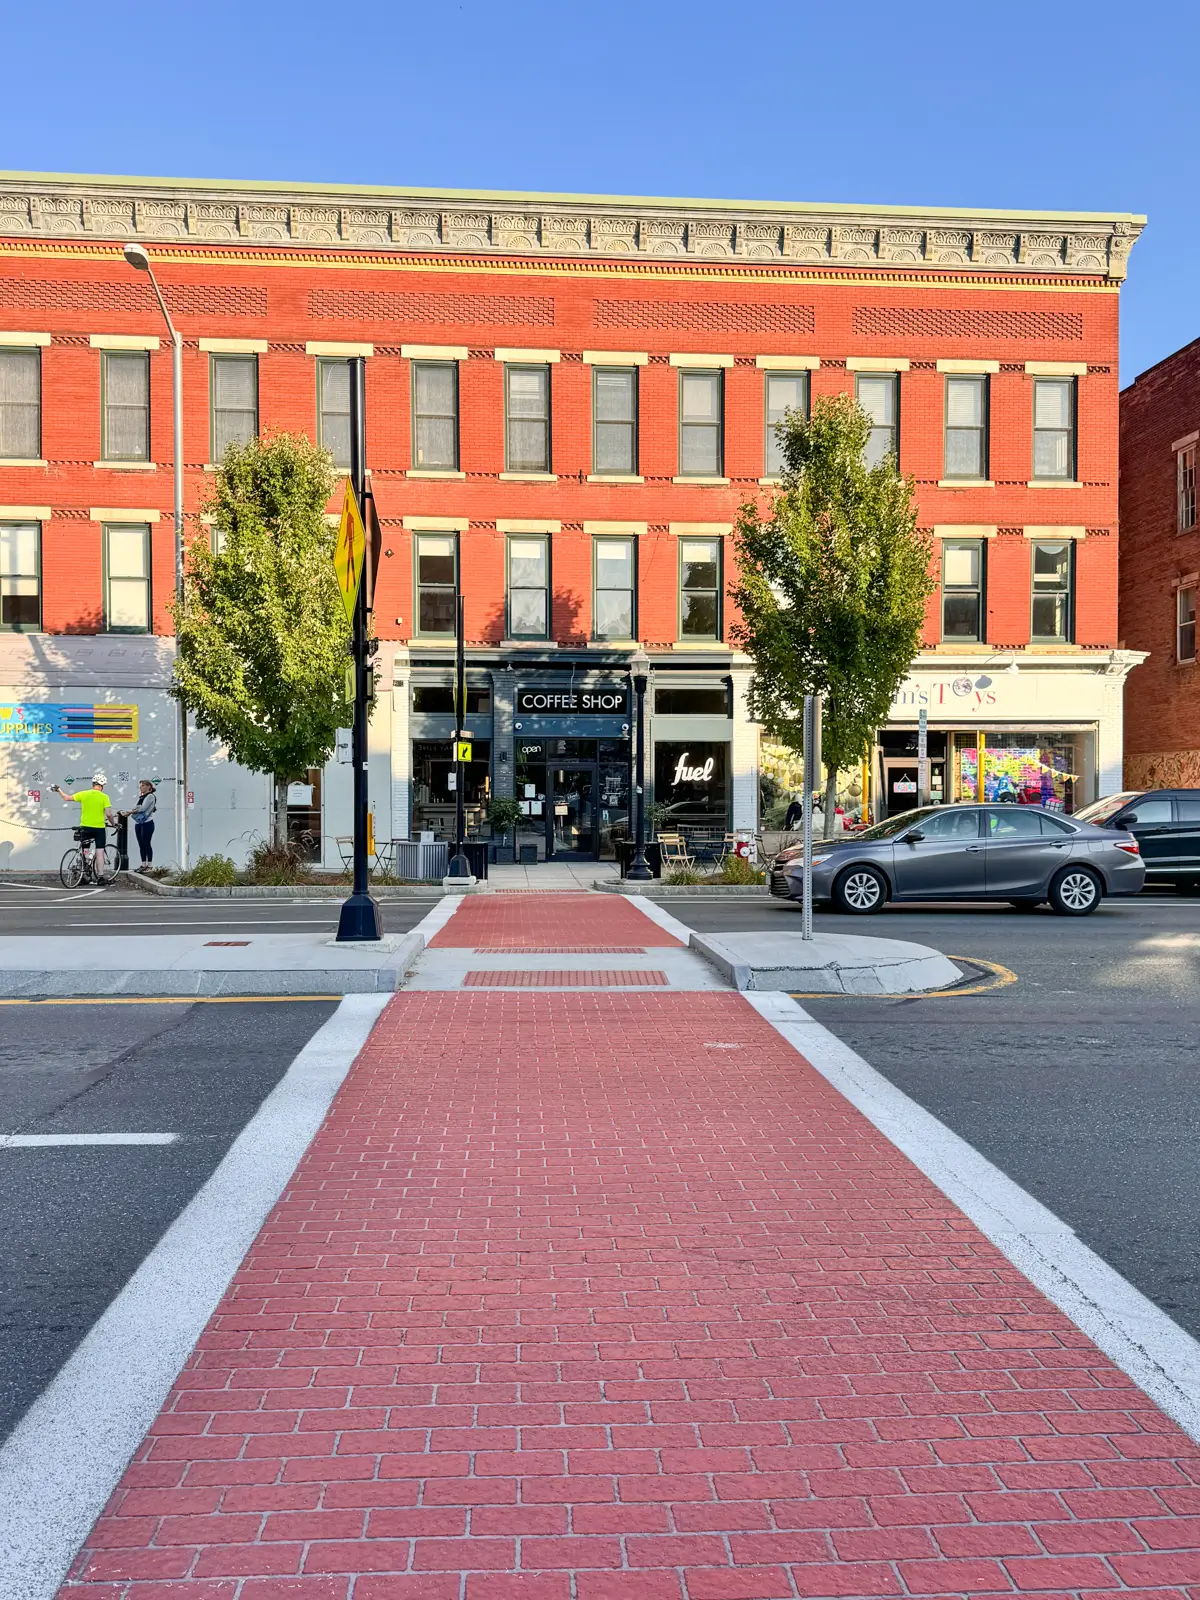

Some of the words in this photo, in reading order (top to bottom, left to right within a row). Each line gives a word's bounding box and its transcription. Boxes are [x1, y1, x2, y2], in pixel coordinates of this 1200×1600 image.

[522, 695, 578, 708] COFFEE
[582, 695, 623, 708] SHOP
[521, 745, 542, 754] open
[671, 752, 714, 786] fuel
